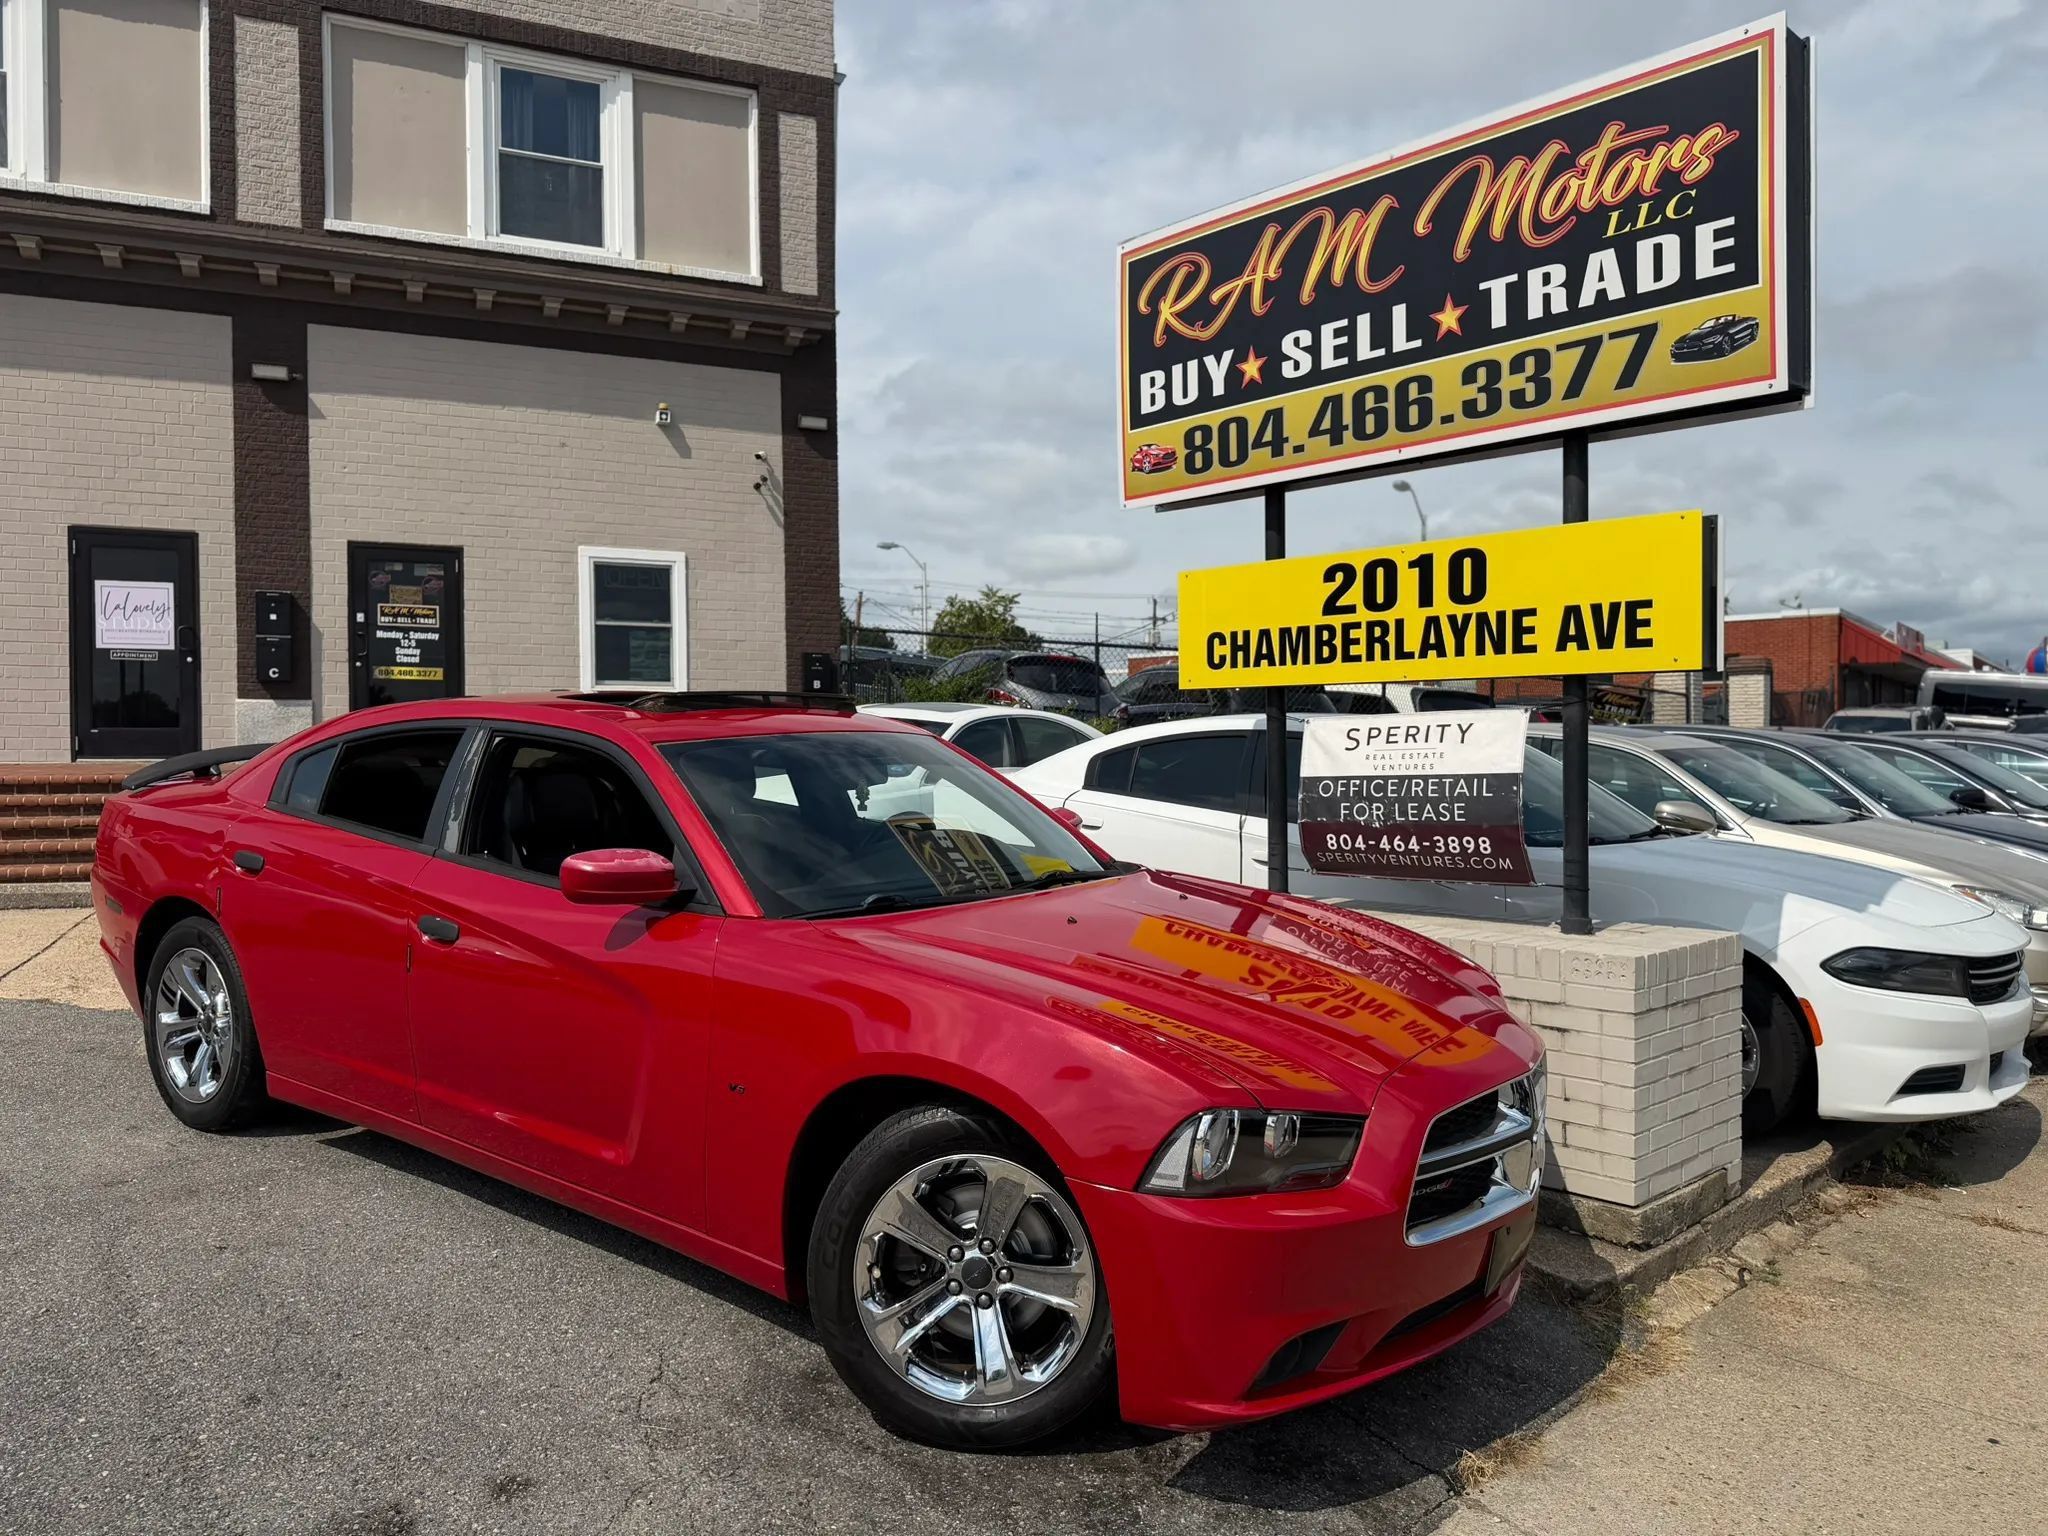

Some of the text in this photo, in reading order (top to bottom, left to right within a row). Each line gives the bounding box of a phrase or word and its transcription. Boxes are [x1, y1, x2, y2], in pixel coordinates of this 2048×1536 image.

[1602, 189, 1697, 239] LLC
[1137, 120, 1739, 348] RAM Motors
[1140, 216, 1736, 415] BUY SELL TRADE
[1183, 322, 1659, 477] 804.466.3377
[1322, 547, 1488, 617] 2010
[376, 630, 404, 640] Monday
[409, 631, 439, 641] Saturday
[400, 639, 416, 647] 12-5
[1206, 598, 1654, 671] CHAMBERLAYNE AVE
[395, 646, 421, 656] Sunday
[396, 655, 420, 663] Closed
[268, 667, 279, 678] C
[1345, 722, 1475, 752] SPERITY
[1365, 751, 1446, 761] REAL ESTATE
[1373, 763, 1436, 772] VENTURES
[1318, 777, 1494, 798] OFFICE/RETAIL
[1340, 802, 1467, 822] FOR LEASE
[1325, 833, 1493, 854] 804-464-3898
[1316, 852, 1514, 871] SPERITYVENTURES.COM
